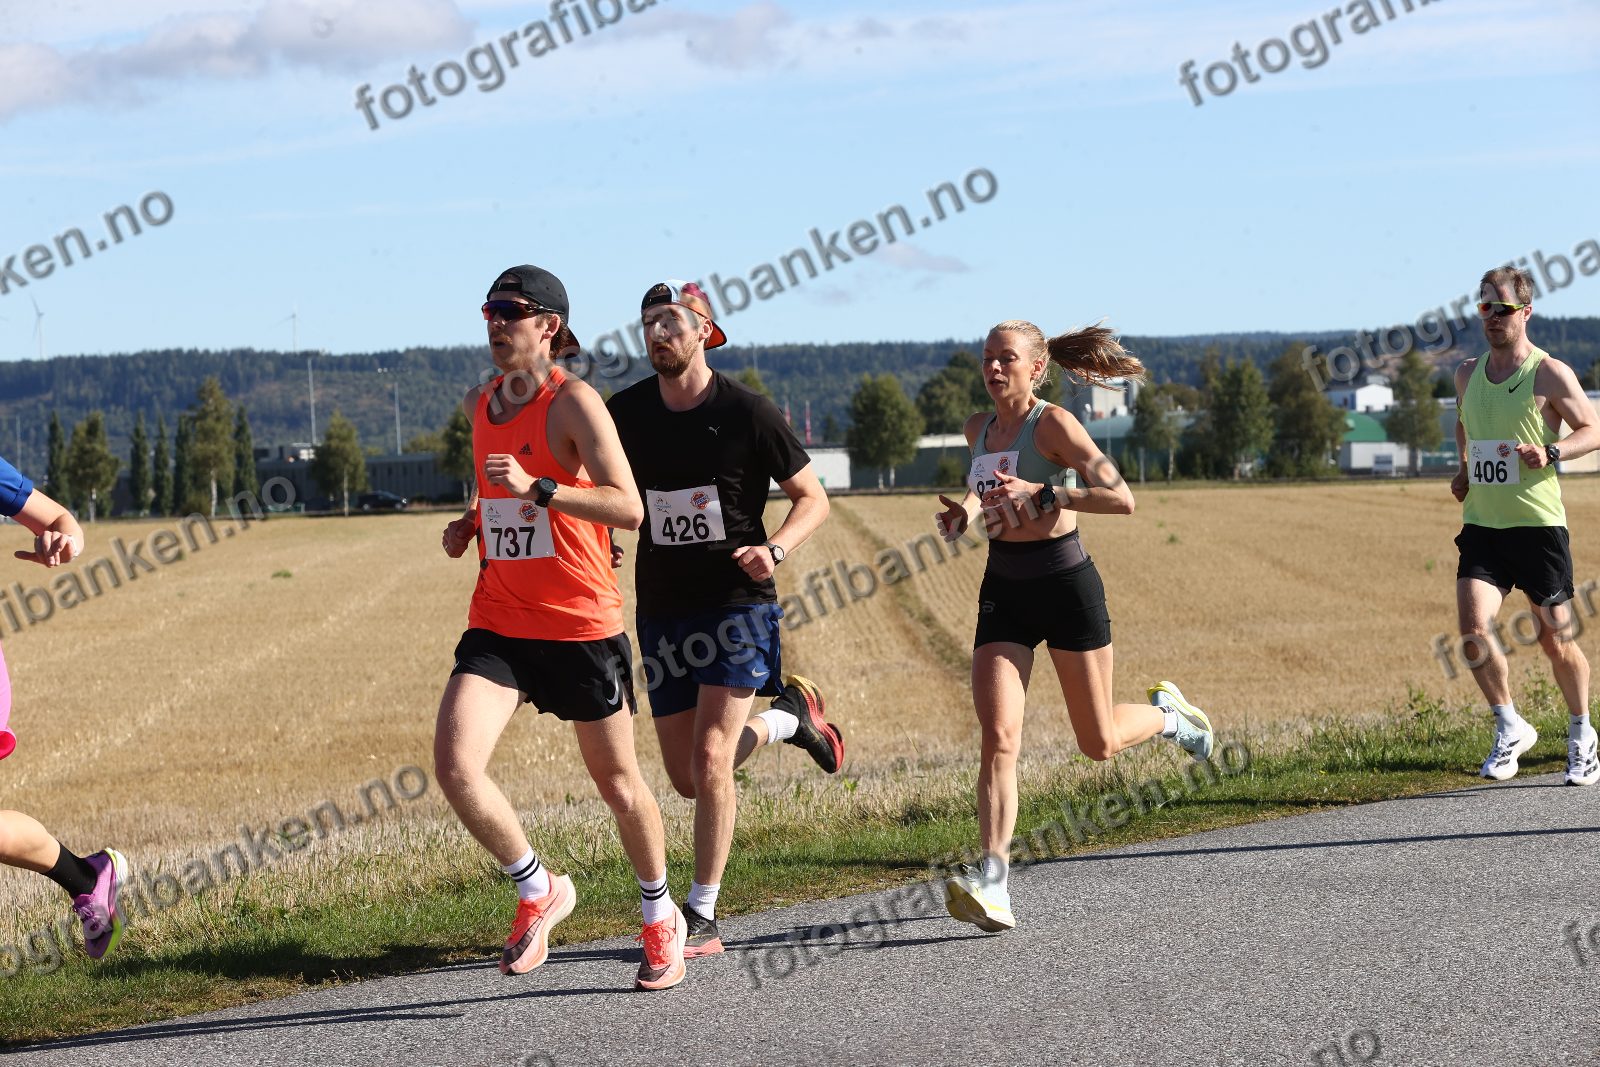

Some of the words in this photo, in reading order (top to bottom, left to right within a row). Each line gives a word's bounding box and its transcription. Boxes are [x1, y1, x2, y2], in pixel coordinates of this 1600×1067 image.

[1474, 460, 1508, 483] 406
[976, 479, 1005, 503] 87
[662, 513, 710, 542] 426
[490, 526, 536, 558] 737
